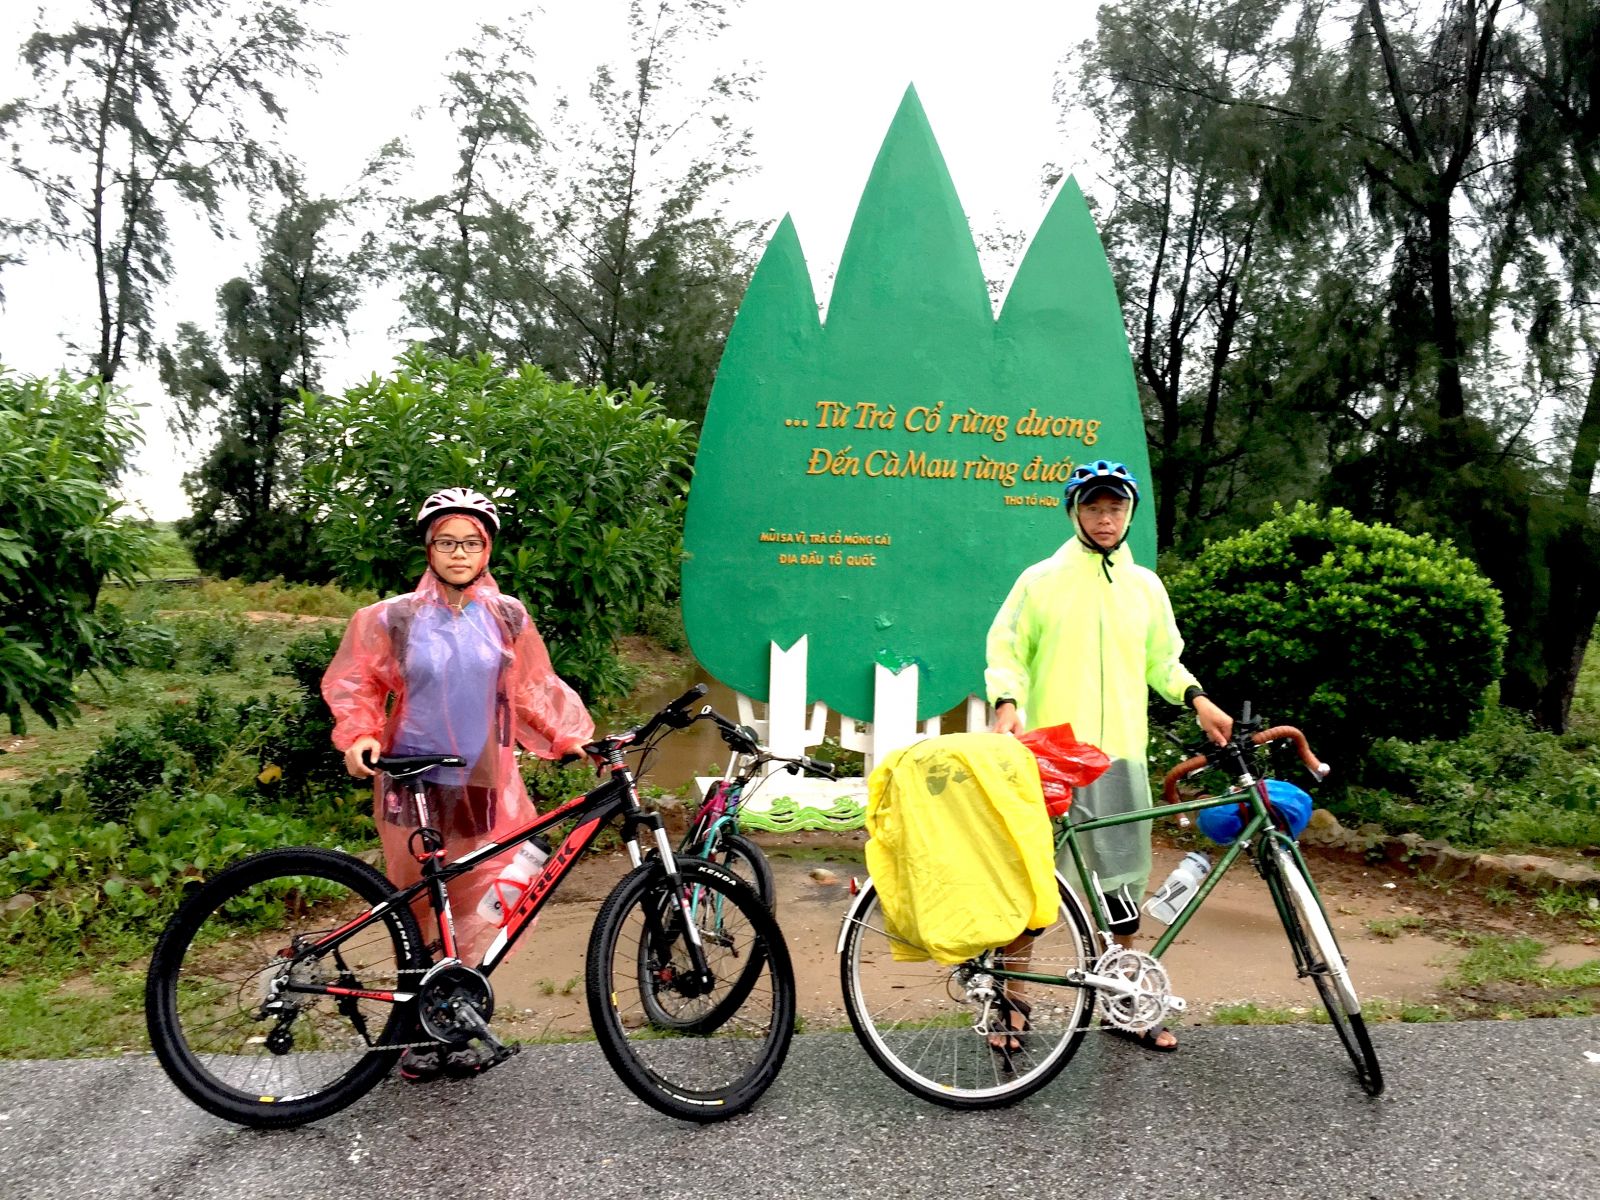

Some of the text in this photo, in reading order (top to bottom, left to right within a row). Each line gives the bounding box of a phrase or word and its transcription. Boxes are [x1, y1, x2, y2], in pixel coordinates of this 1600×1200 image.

[815, 400, 851, 429] Từ
[854, 402, 897, 430] Trà
[904, 400, 944, 433] Cổ
[948, 407, 1010, 442] rừng
[1015, 408, 1102, 446] dương
[806, 445, 1075, 487] Đến Cà Mau rừng đướ
[846, 553, 878, 567] QUỐC
[512, 840, 577, 918] TREK
[697, 866, 737, 886] KENDA
[390, 911, 412, 961] KENDA
